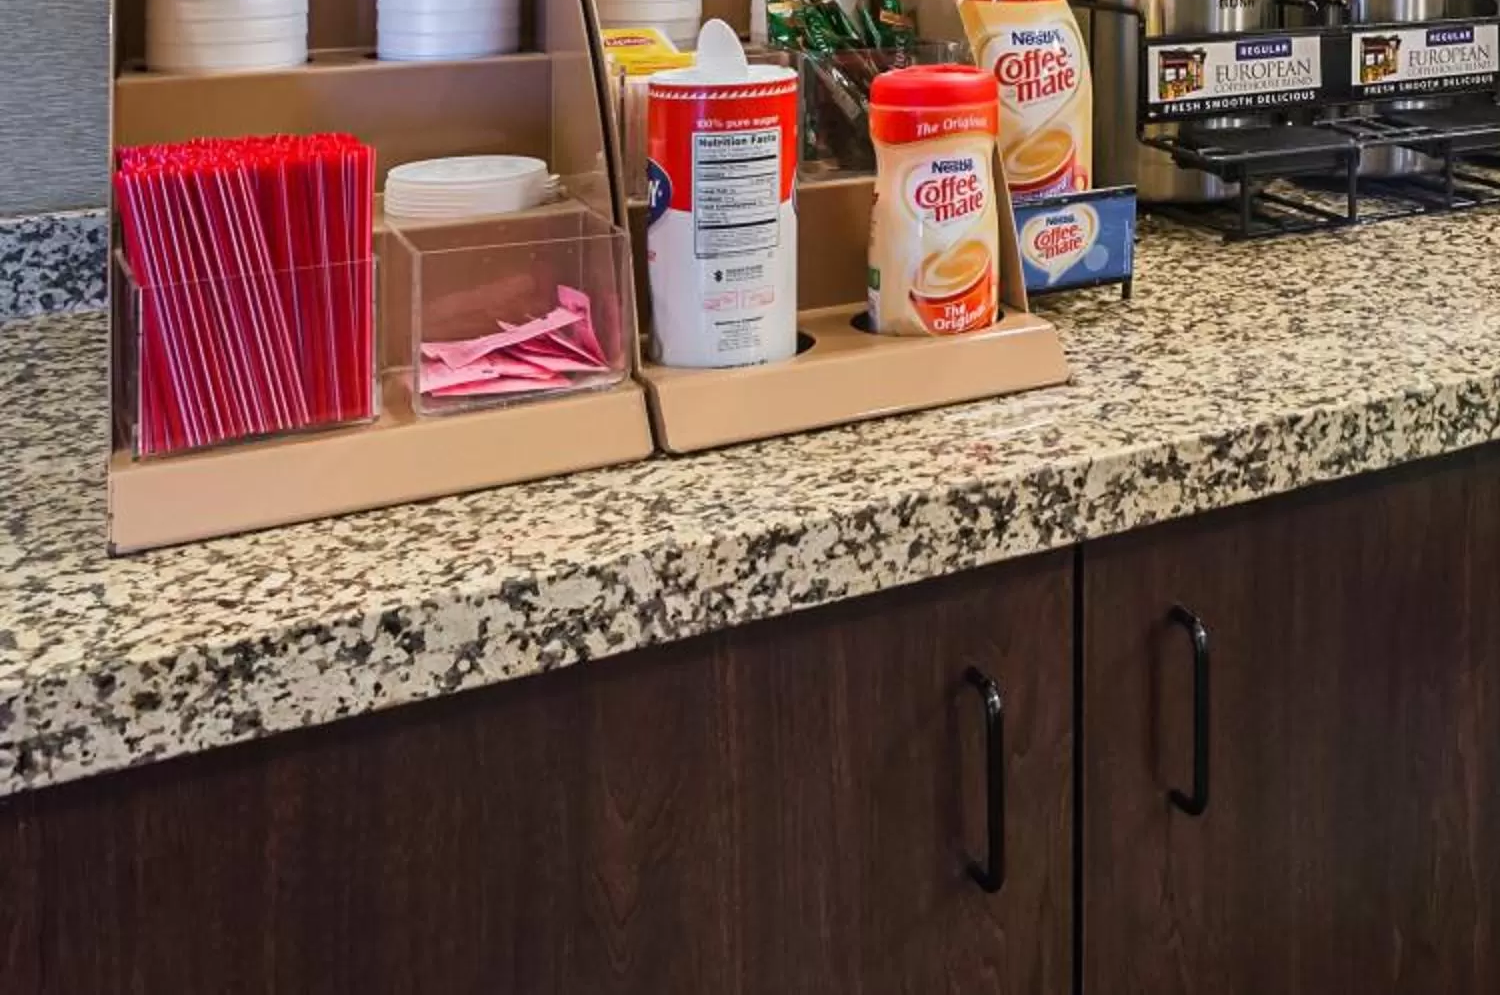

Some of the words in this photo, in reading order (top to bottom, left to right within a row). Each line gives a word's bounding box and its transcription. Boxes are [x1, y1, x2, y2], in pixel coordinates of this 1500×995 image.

[1430, 30, 1471, 42] REGULAR
[1240, 43, 1289, 56] REGULAR
[1409, 45, 1490, 67] EUROPEAN
[994, 46, 1067, 85] Coffee
[1215, 57, 1311, 84] EUROPEAN
[1017, 68, 1075, 102] mate
[1364, 85, 1395, 95] FRESH
[1400, 79, 1439, 90] SMOOTH
[1443, 74, 1494, 86] DELICIOUS
[1164, 104, 1201, 115] FRESH
[1205, 98, 1253, 110] SMOOTH
[1257, 90, 1315, 105] DELICIOUS
[726, 118, 750, 130] pure
[916, 122, 939, 136] The
[698, 137, 748, 149] Nutrition
[751, 134, 777, 146] Facts
[915, 174, 977, 209] Coffee
[935, 191, 984, 222] mate
[1034, 225, 1078, 251] Coffee
[944, 303, 966, 318] The
